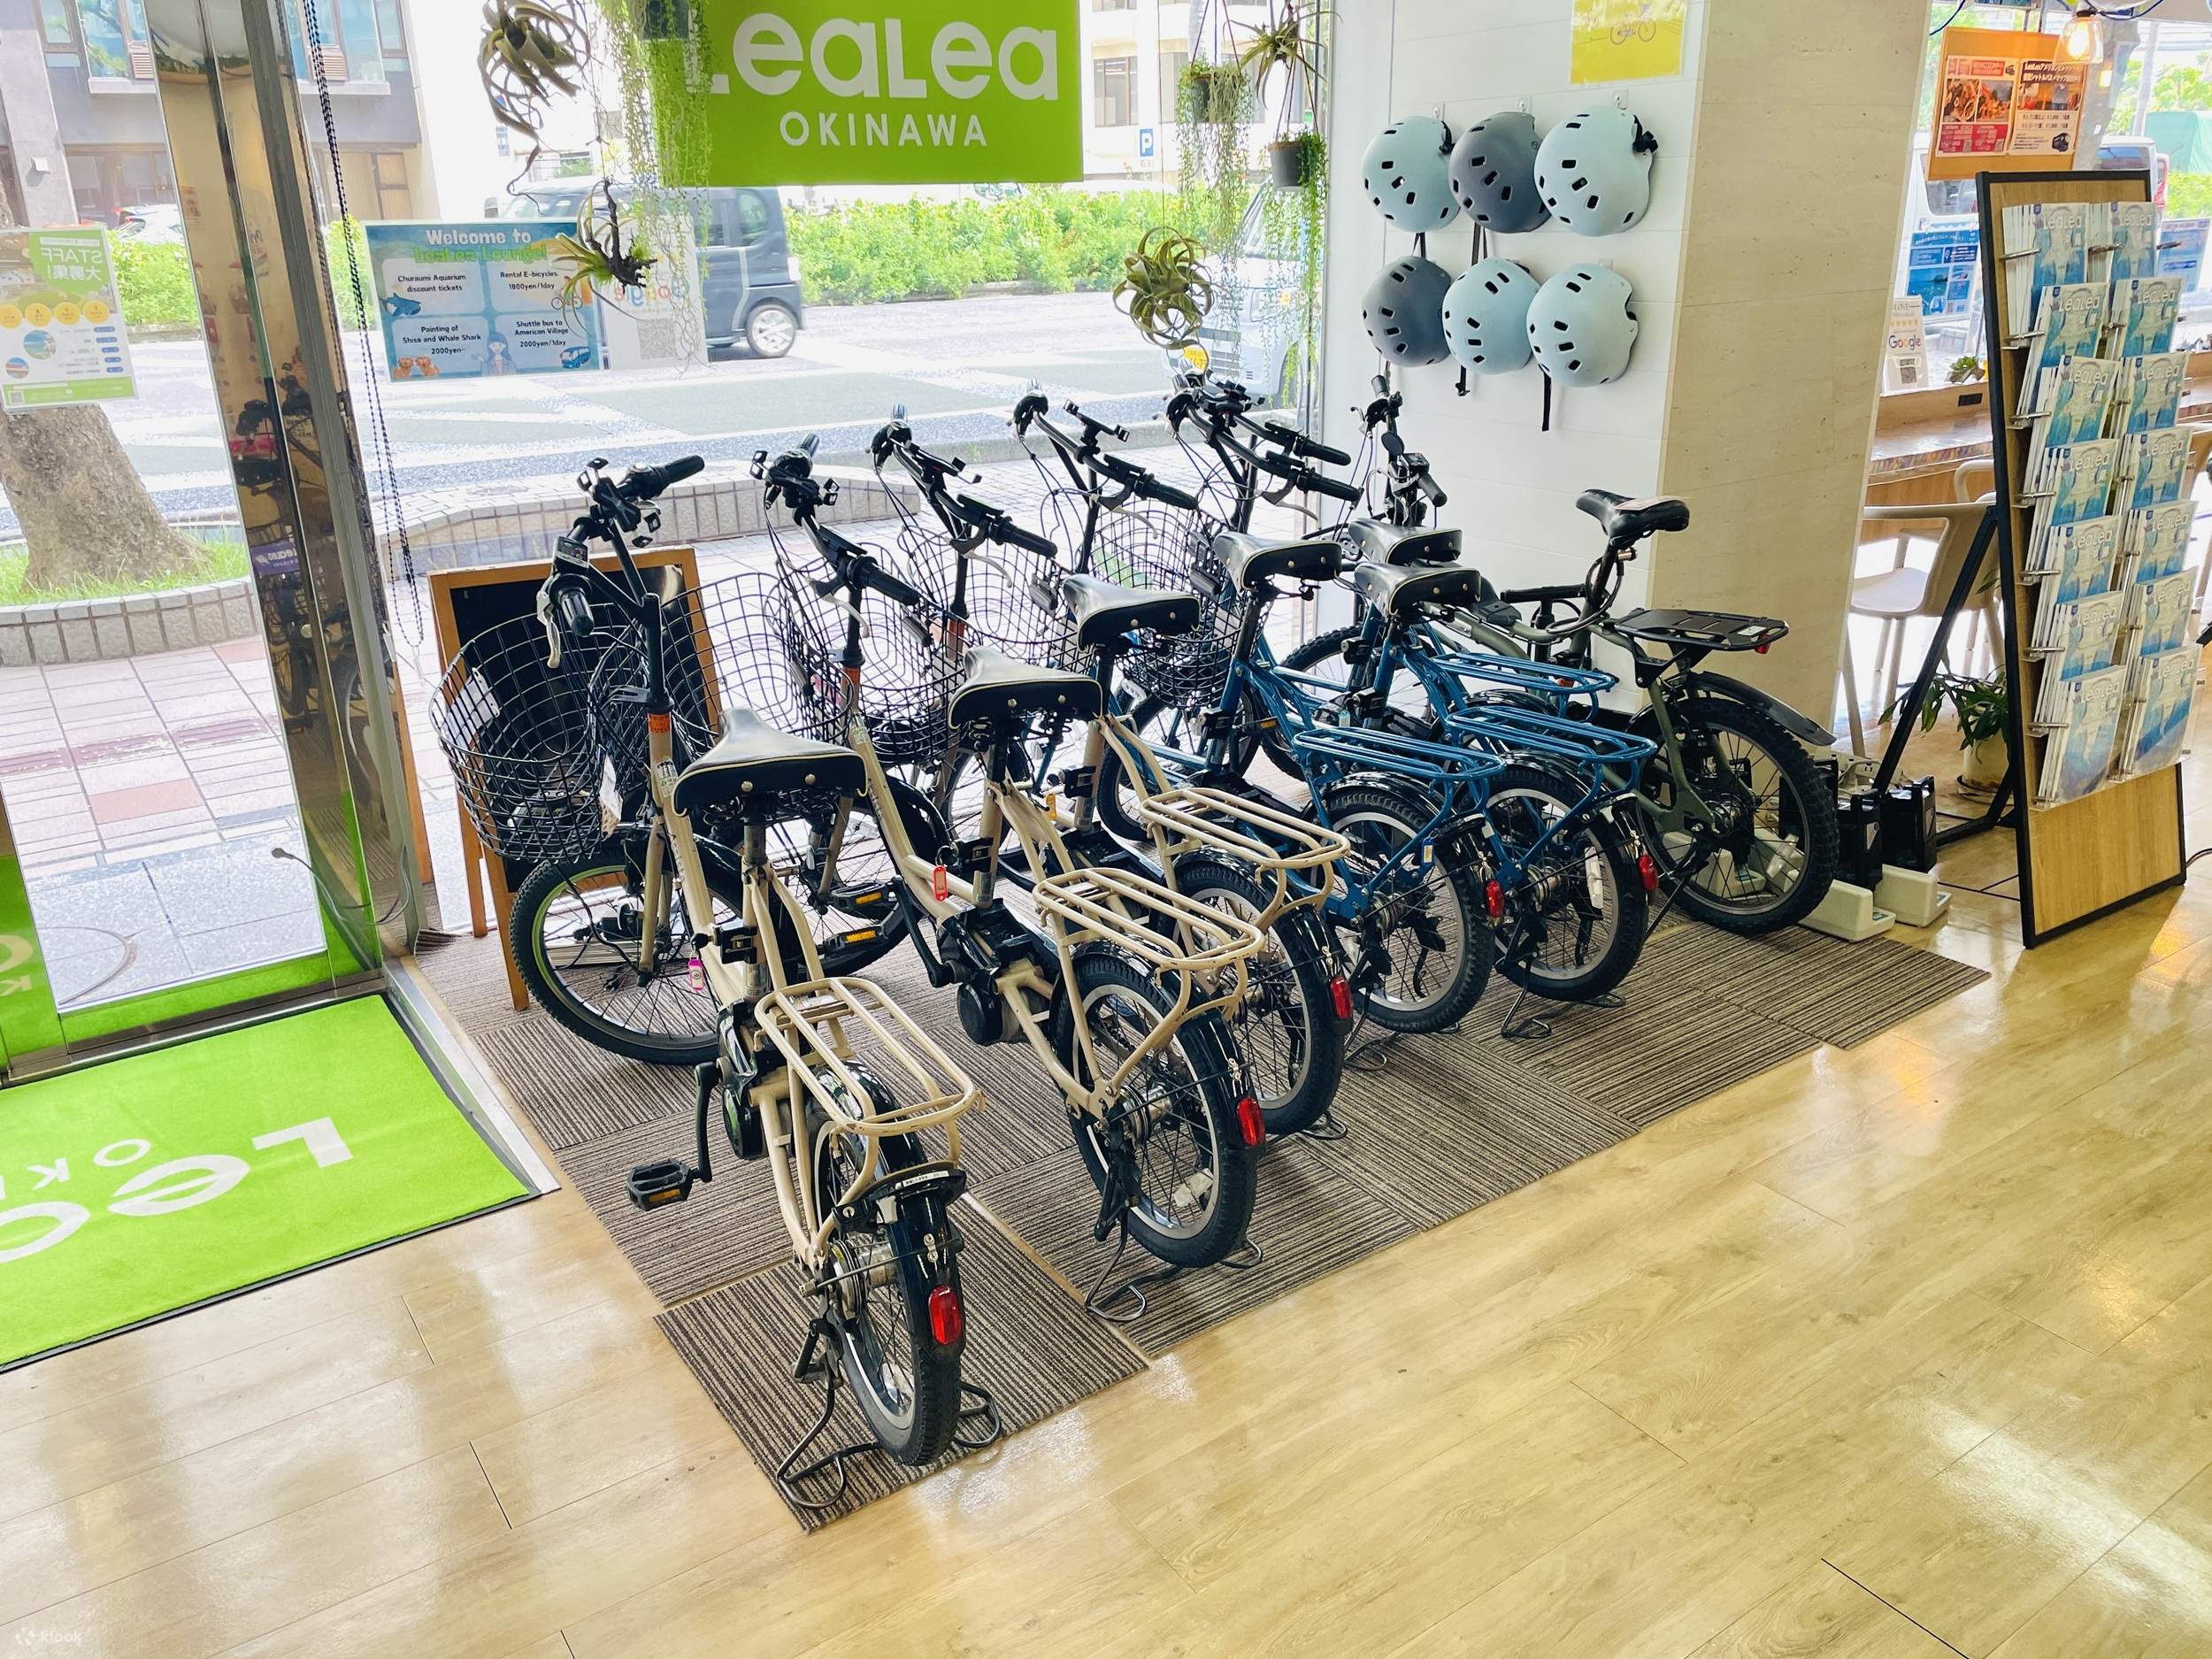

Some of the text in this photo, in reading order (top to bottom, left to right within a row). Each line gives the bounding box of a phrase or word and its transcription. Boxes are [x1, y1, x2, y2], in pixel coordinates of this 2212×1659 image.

[780, 111, 987, 147] OKINAWA
[1141, 132, 1152, 153] P
[425, 228, 532, 245] Welcome to
[1888, 334, 1922, 351] Google
